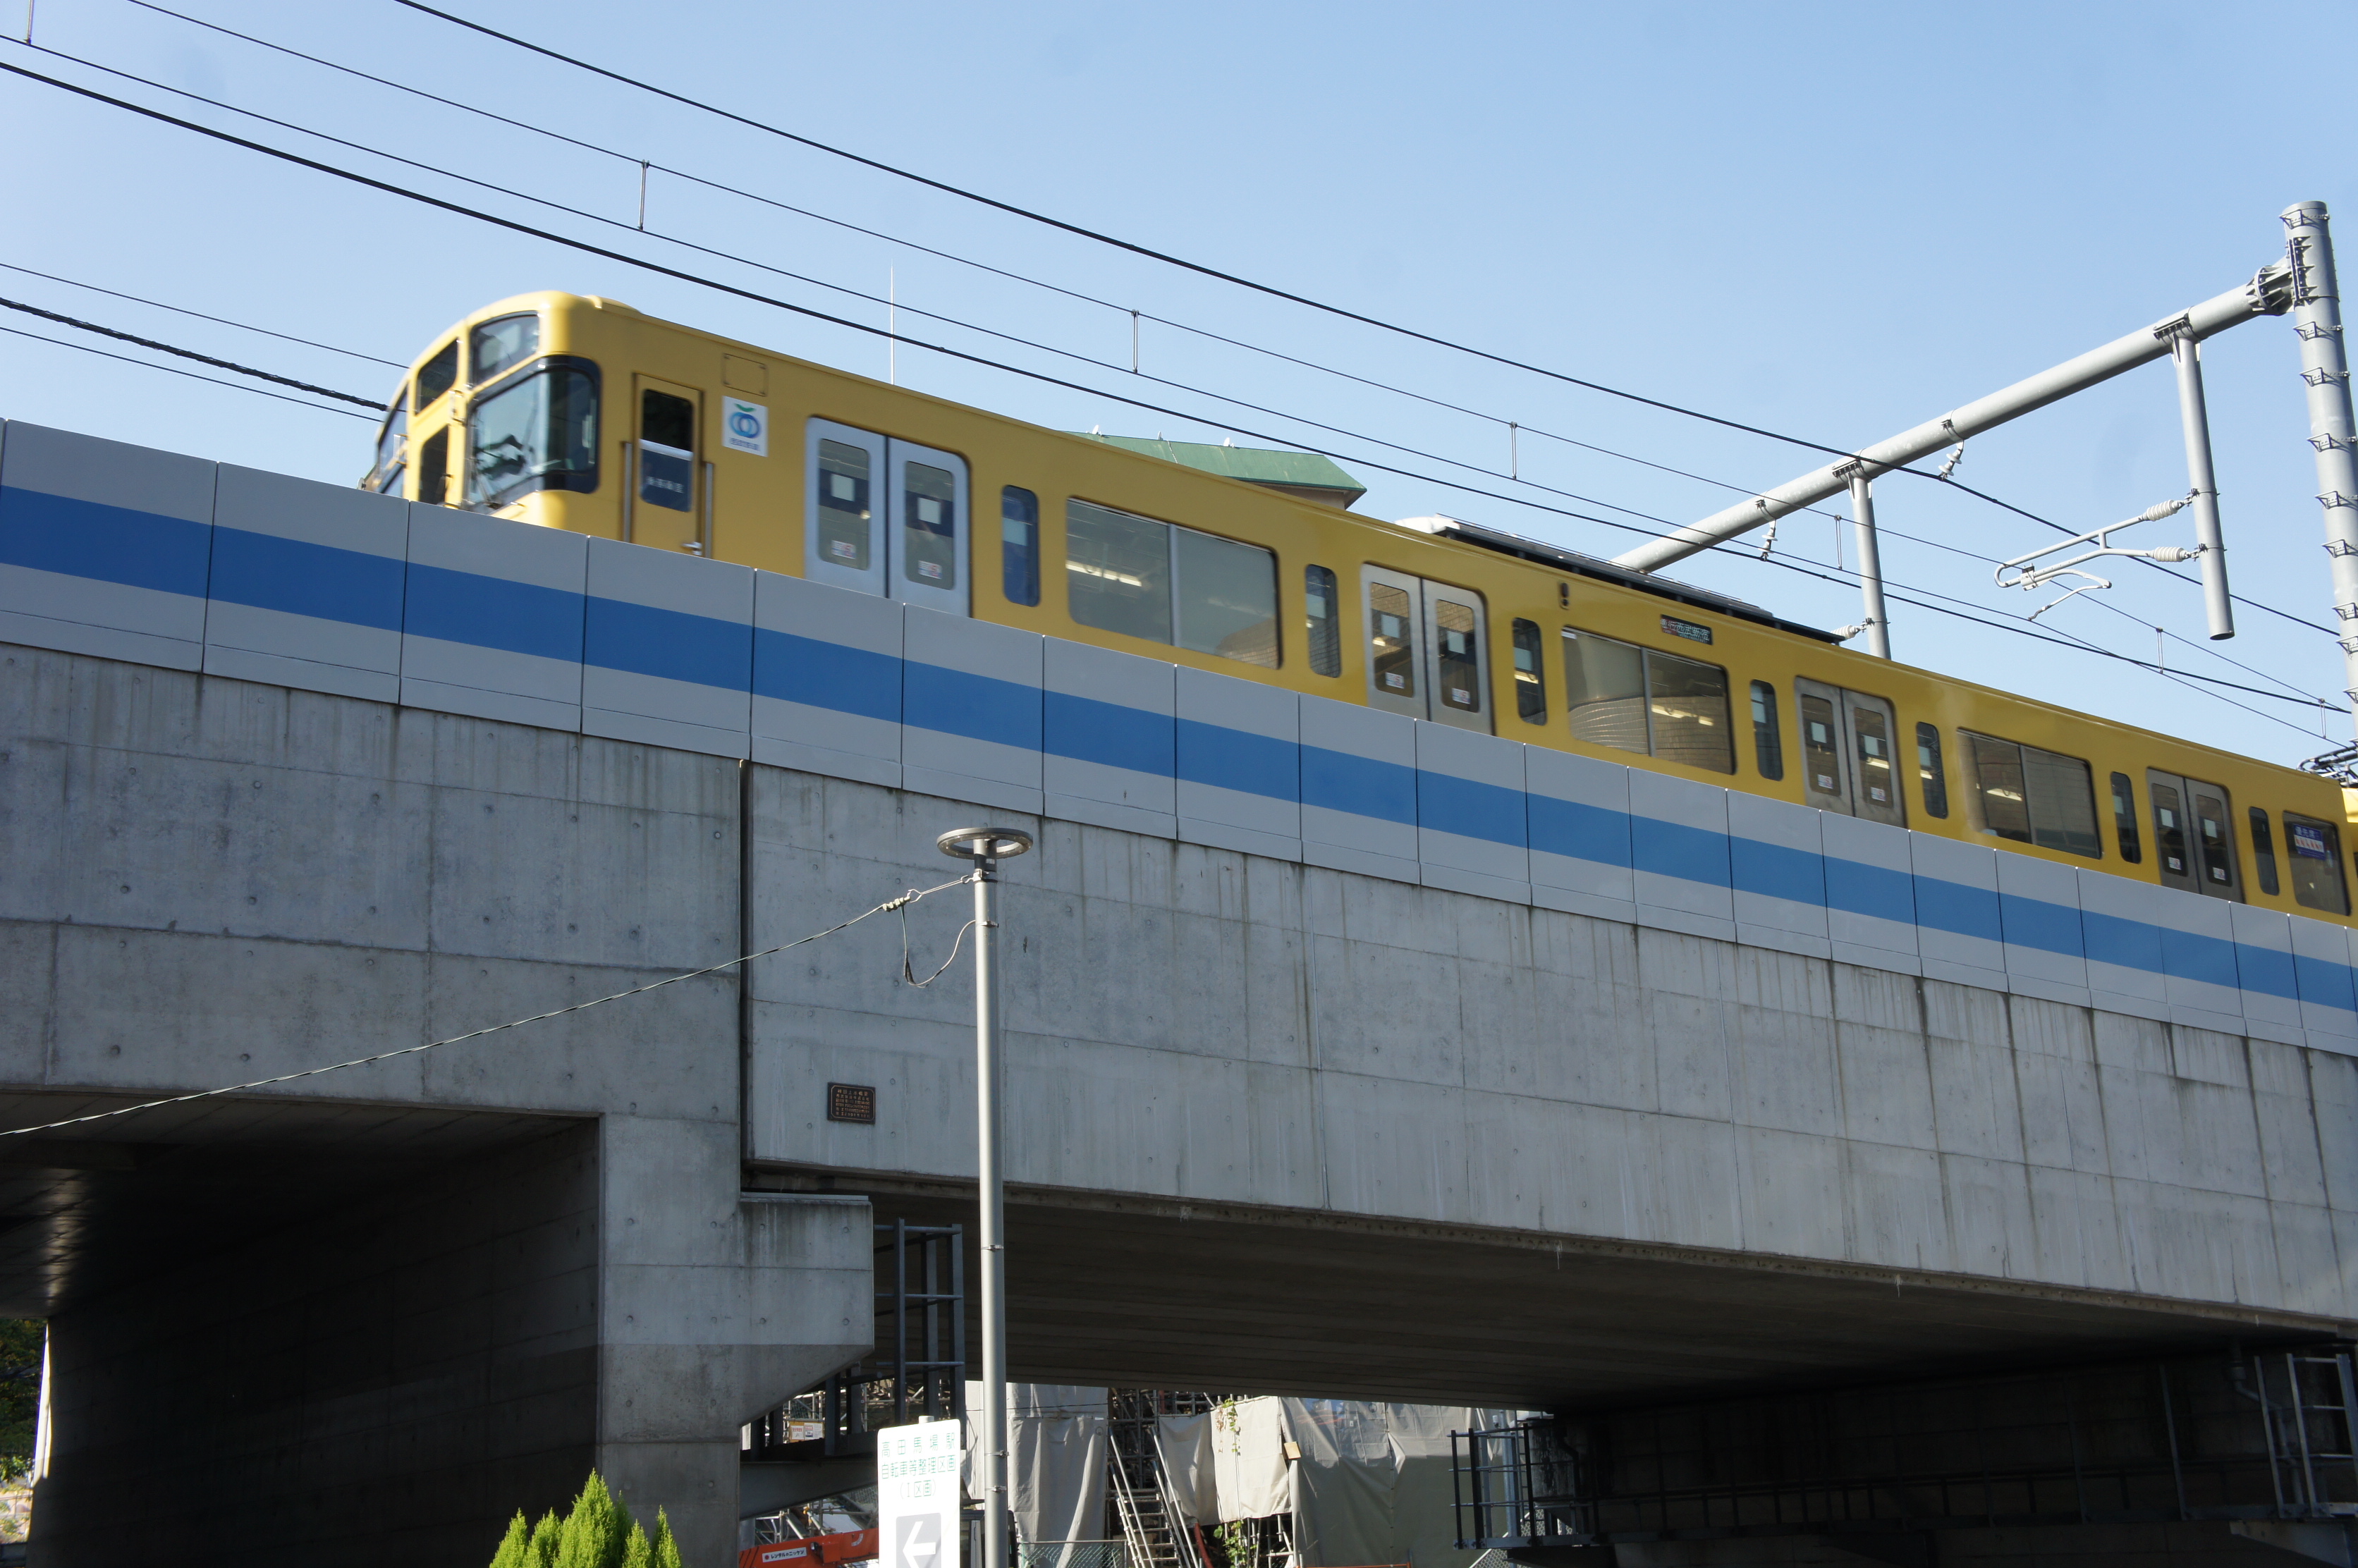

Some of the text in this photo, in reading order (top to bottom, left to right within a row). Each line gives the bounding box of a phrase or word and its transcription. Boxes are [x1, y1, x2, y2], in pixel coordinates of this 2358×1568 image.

[881, 1432, 955, 1458] 高田馬場駅
[881, 1454, 956, 1479] 自転車等整理区画
[771, 1550, 805, 1560] レンタルのニッケン
